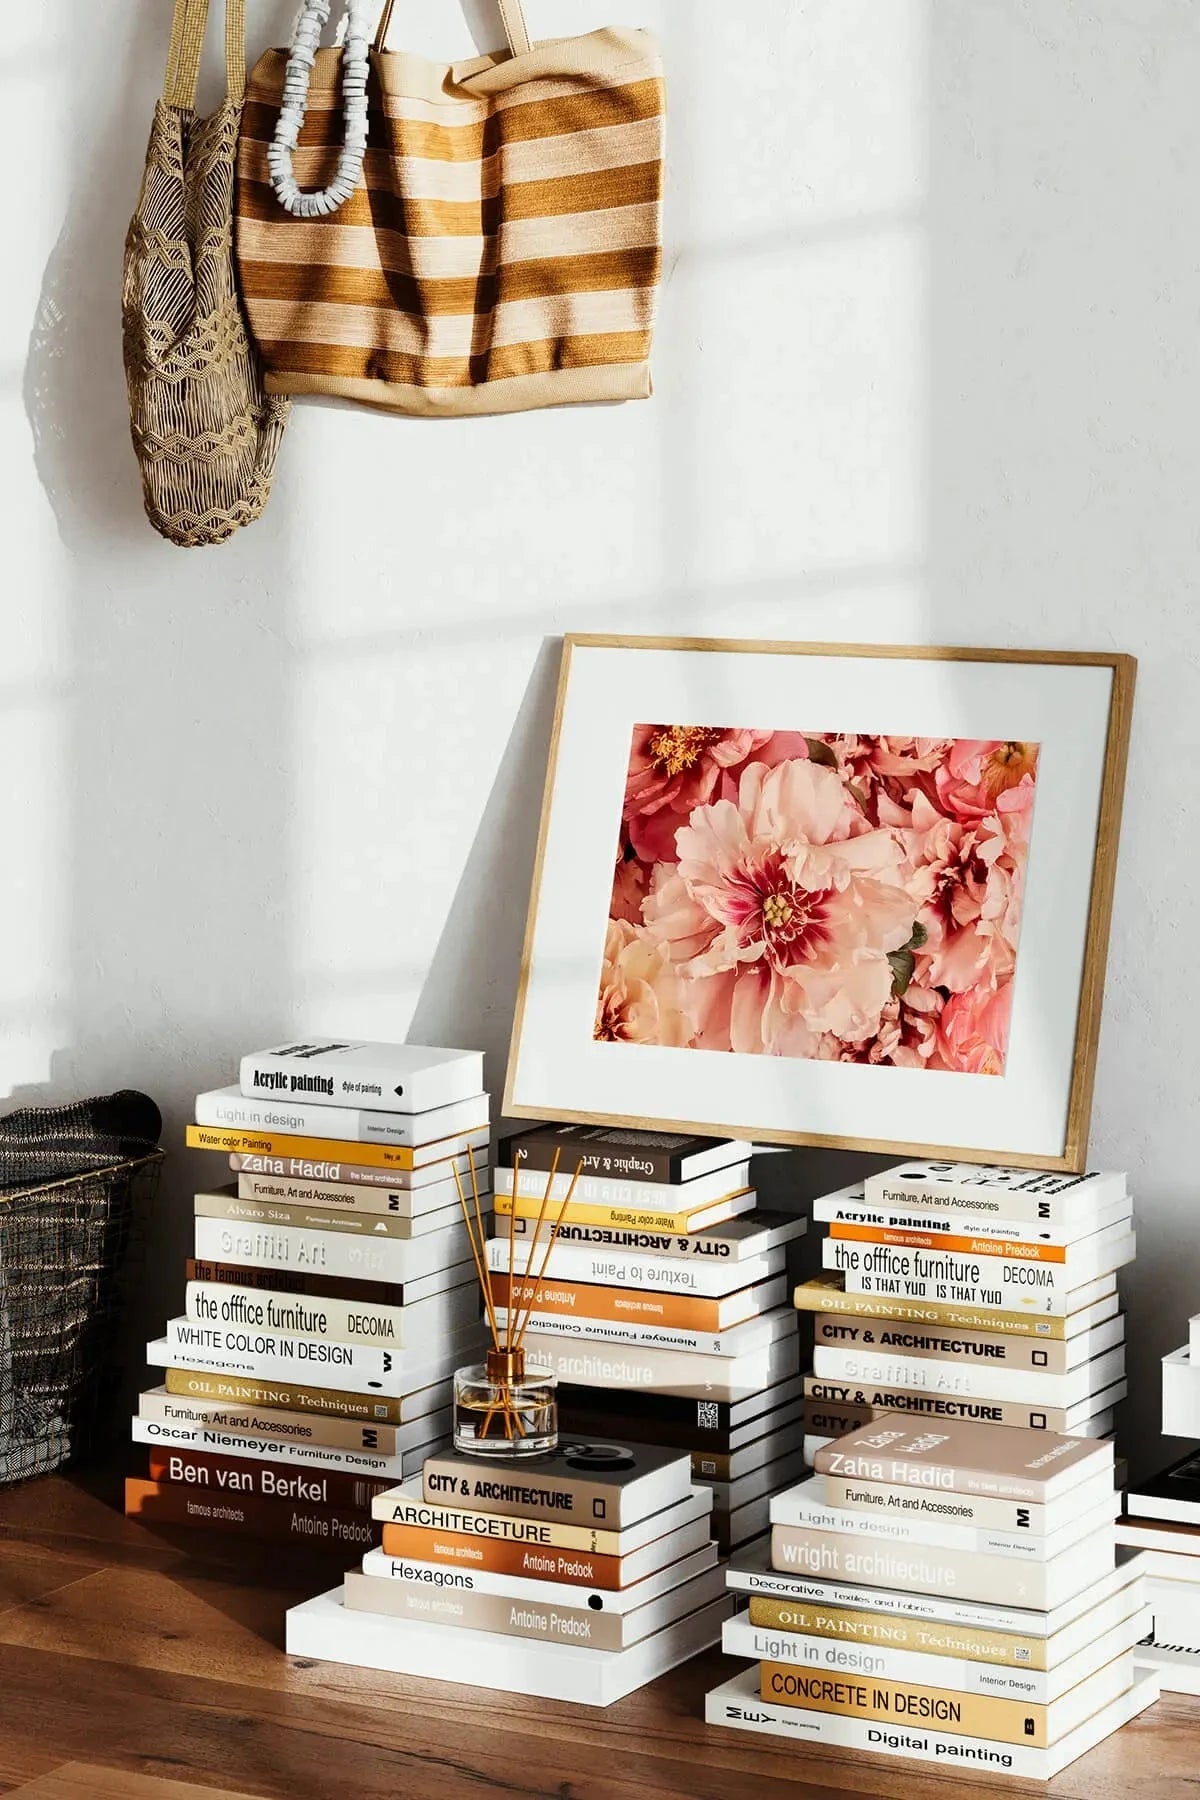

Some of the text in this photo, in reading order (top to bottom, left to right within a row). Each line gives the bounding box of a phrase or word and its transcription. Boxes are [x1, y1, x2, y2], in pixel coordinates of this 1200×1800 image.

[253, 1070, 288, 1090] Acrylic
[290, 1074, 334, 1096] painting
[216, 1106, 305, 1128] Light in design
[199, 1133, 272, 1152] Water color Painting
[241, 1154, 340, 1180] Zaha Hadid
[582, 1156, 654, 1175] Graphic & Art
[287, 1186, 298, 1198] Art
[299, 1188, 312, 1200] and
[312, 1189, 355, 1204] Accessories
[920, 1194, 933, 1204] Art
[934, 1196, 950, 1206] and
[950, 1197, 1000, 1212] Accessories
[226, 1204, 290, 1221] Alvaro Siza
[610, 1210, 675, 1229] Water color Painting
[836, 1210, 951, 1232] Acrylic painting
[221, 1230, 289, 1261] Graffiti
[298, 1238, 326, 1266] Art
[550, 1224, 730, 1256] CITY & ARCHITECTURE
[970, 1240, 1004, 1254] Antoine
[1005, 1243, 1040, 1258] Predock
[592, 1262, 697, 1288] Texture to Paint
[834, 1243, 860, 1270] the
[914, 1250, 980, 1284] furniture
[1003, 1265, 1054, 1288] DECOMA
[544, 1289, 576, 1306] Antoine
[862, 1276, 872, 1290] IS
[874, 1277, 902, 1293] THAT
[936, 1284, 946, 1298] IS
[950, 1286, 976, 1302] THAT
[195, 1290, 218, 1320] the
[266, 1298, 327, 1334] furniture
[347, 1313, 395, 1338] DECOMA
[820, 1298, 1030, 1330] OIL PAINTING Techniques
[176, 1327, 353, 1366] WHITE COLOR IN DESIGN
[585, 1326, 637, 1340] Furniture
[640, 1334, 697, 1348] Niemeyer
[822, 1324, 1006, 1359] CITY & ARCHITECTURE
[173, 1354, 255, 1371] Hexagons
[558, 1354, 654, 1385] architecture
[188, 1380, 369, 1414] OIL PAINTING Techniques
[811, 1384, 1003, 1422] CITY & ARCHITECTURE
[164, 1405, 312, 1438] Furniture, Art and Accessories
[811, 1414, 850, 1430] CITY
[147, 1424, 387, 1468] Oscar Niemeyer Furniture Design
[169, 1456, 327, 1502] Ben van Berkel
[828, 1453, 956, 1488] Zaha Hadid
[428, 1473, 573, 1510] CITY & ARCHITECTURE
[845, 1488, 974, 1518] Furniture, Art and Accessories
[187, 1500, 373, 1544] famous architects Antoine Predock
[392, 1504, 552, 1543] ARCHITECETURE
[799, 1511, 910, 1537] Light in design
[391, 1560, 474, 1589] Hexagons
[523, 1552, 556, 1572] Antoine
[558, 1557, 594, 1578] Predock
[782, 1542, 956, 1587] wright architecture
[748, 1576, 825, 1597] Decorative
[510, 1606, 547, 1631] Antoine
[550, 1612, 591, 1638] Predock
[778, 1610, 1008, 1657] OIL PAINTING Techniques
[754, 1634, 886, 1672] Light in design
[771, 1672, 961, 1722] CONCRETE IN DESIGN
[979, 1675, 1036, 1692] Interior Design
[867, 1729, 1013, 1768] Digital painting
